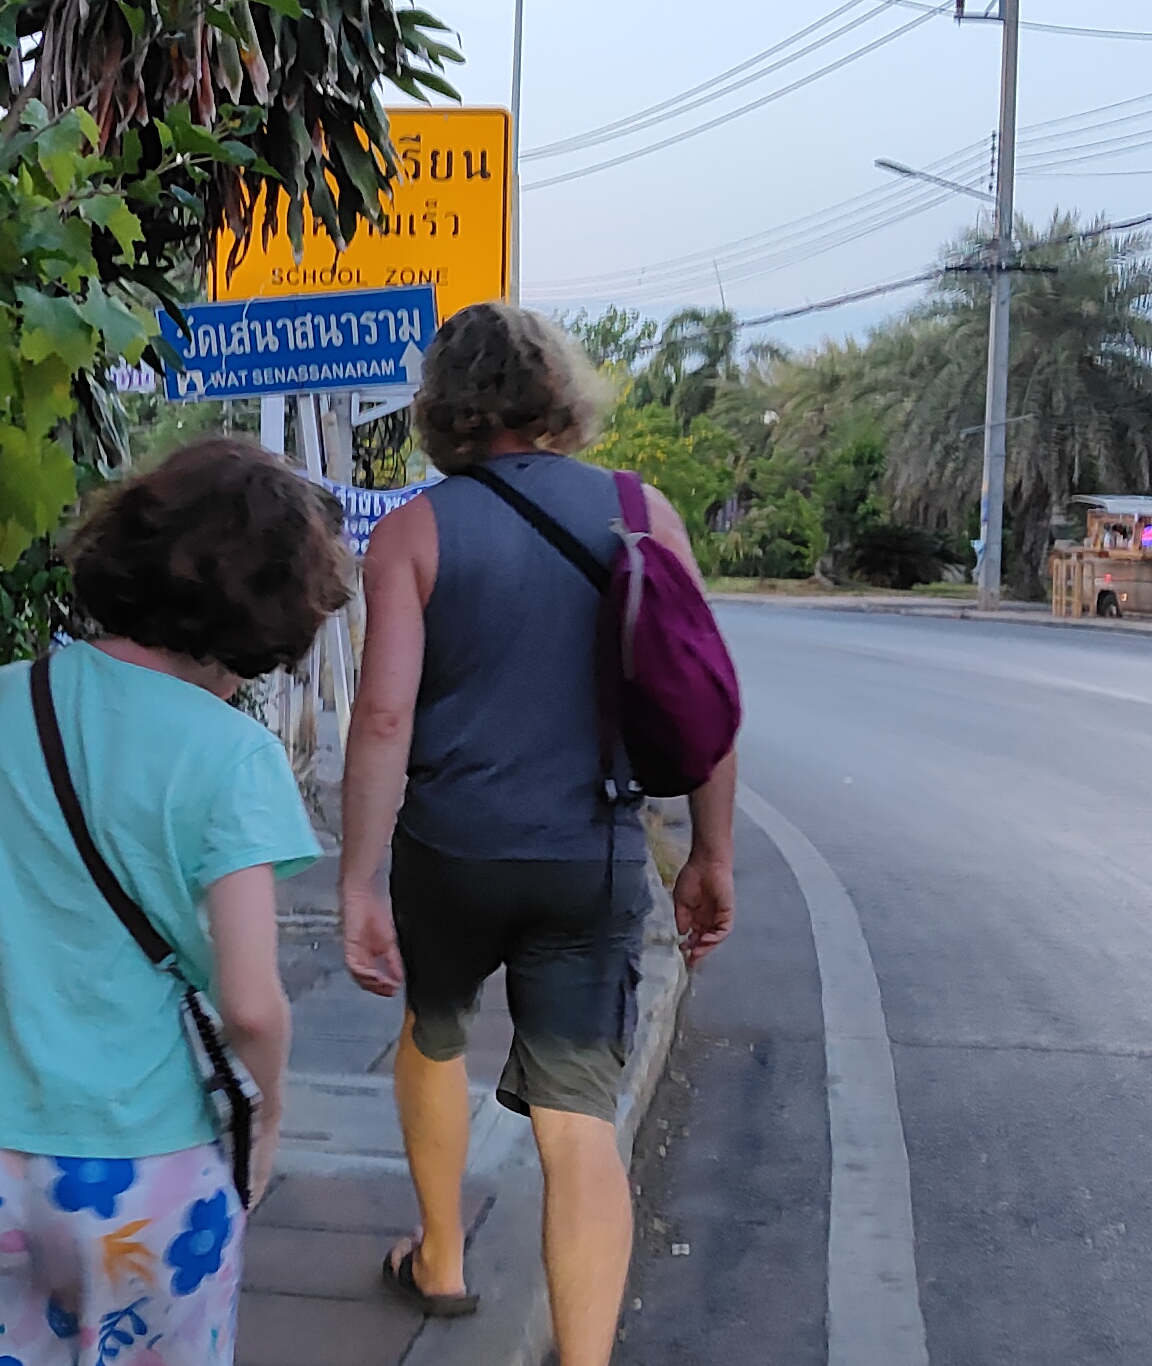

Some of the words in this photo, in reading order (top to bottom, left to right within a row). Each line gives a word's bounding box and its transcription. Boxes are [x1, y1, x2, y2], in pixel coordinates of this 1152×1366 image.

[271, 266, 368, 287] SCHOOL
[385, 266, 449, 287] ZONE
[210, 368, 249, 389] WAT
[252, 357, 396, 387] SENASSANARAM
